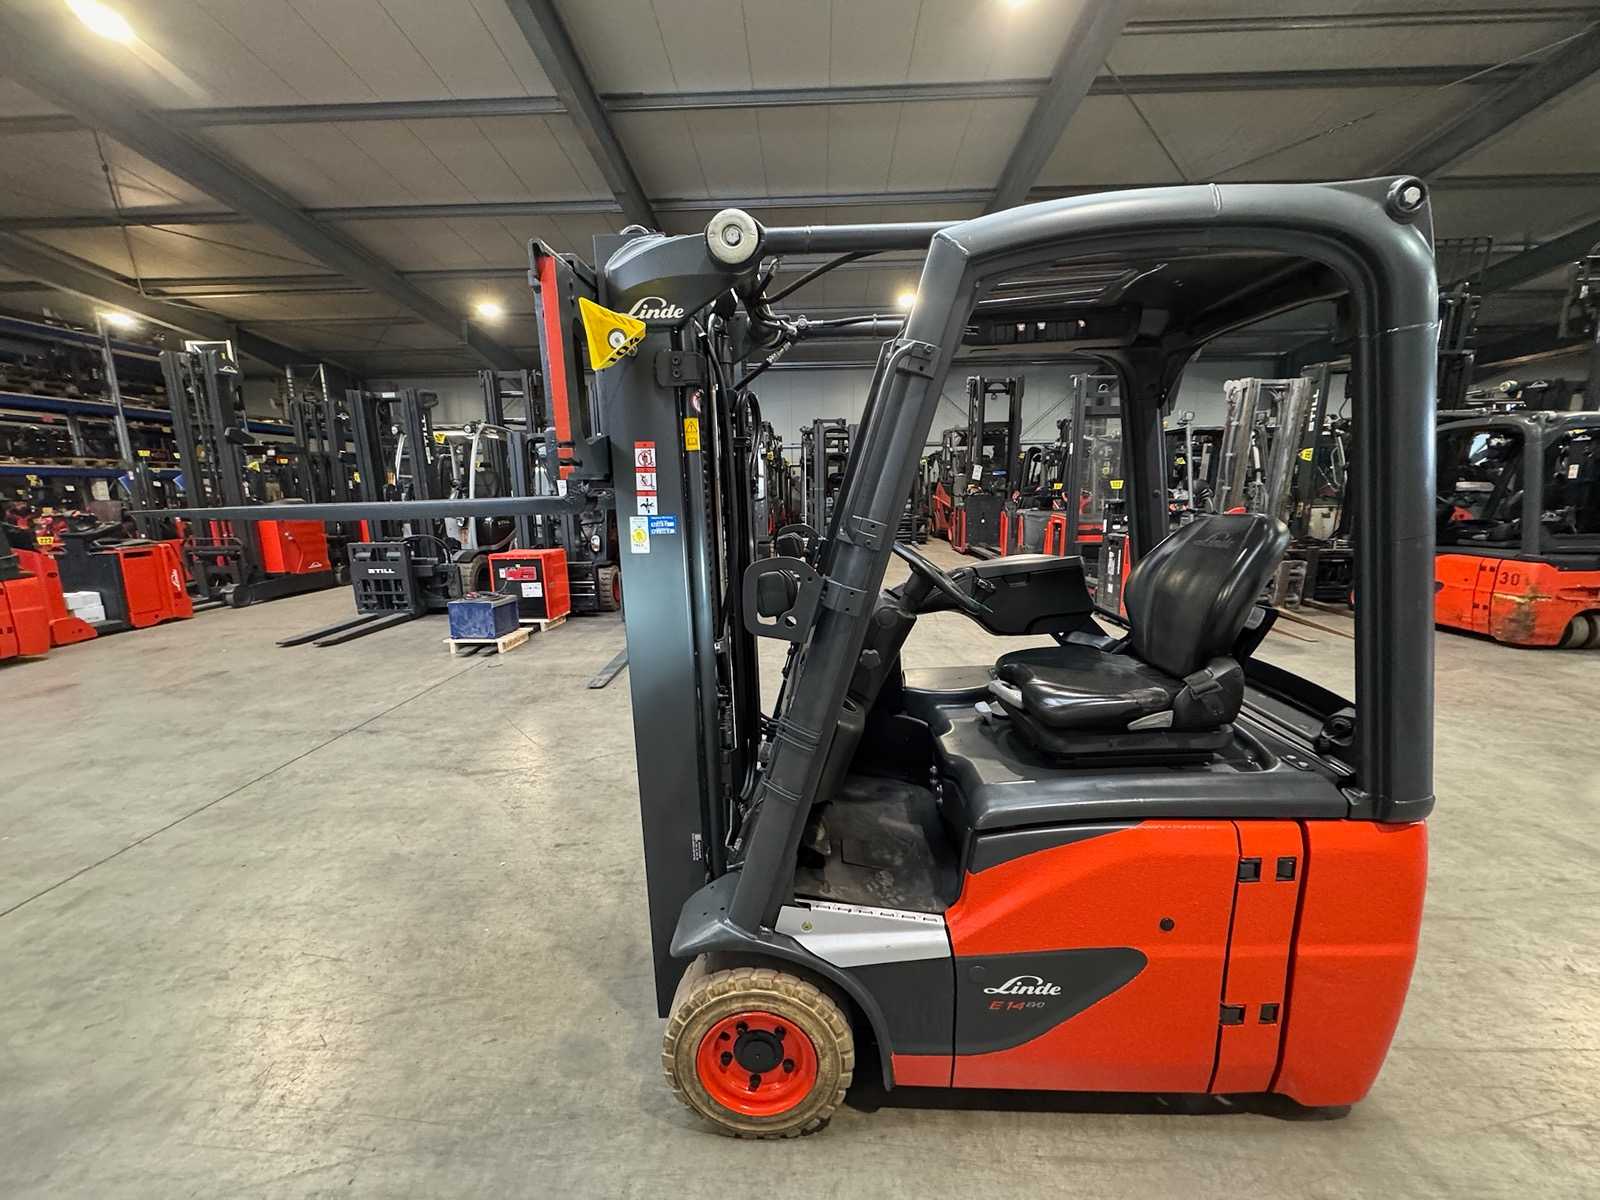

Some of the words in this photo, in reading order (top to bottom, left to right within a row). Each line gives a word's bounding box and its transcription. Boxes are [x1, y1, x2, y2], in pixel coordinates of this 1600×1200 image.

[626, 296, 685, 320] Linde
[1499, 571, 1520, 586] 30
[983, 975, 1062, 996] Linde
